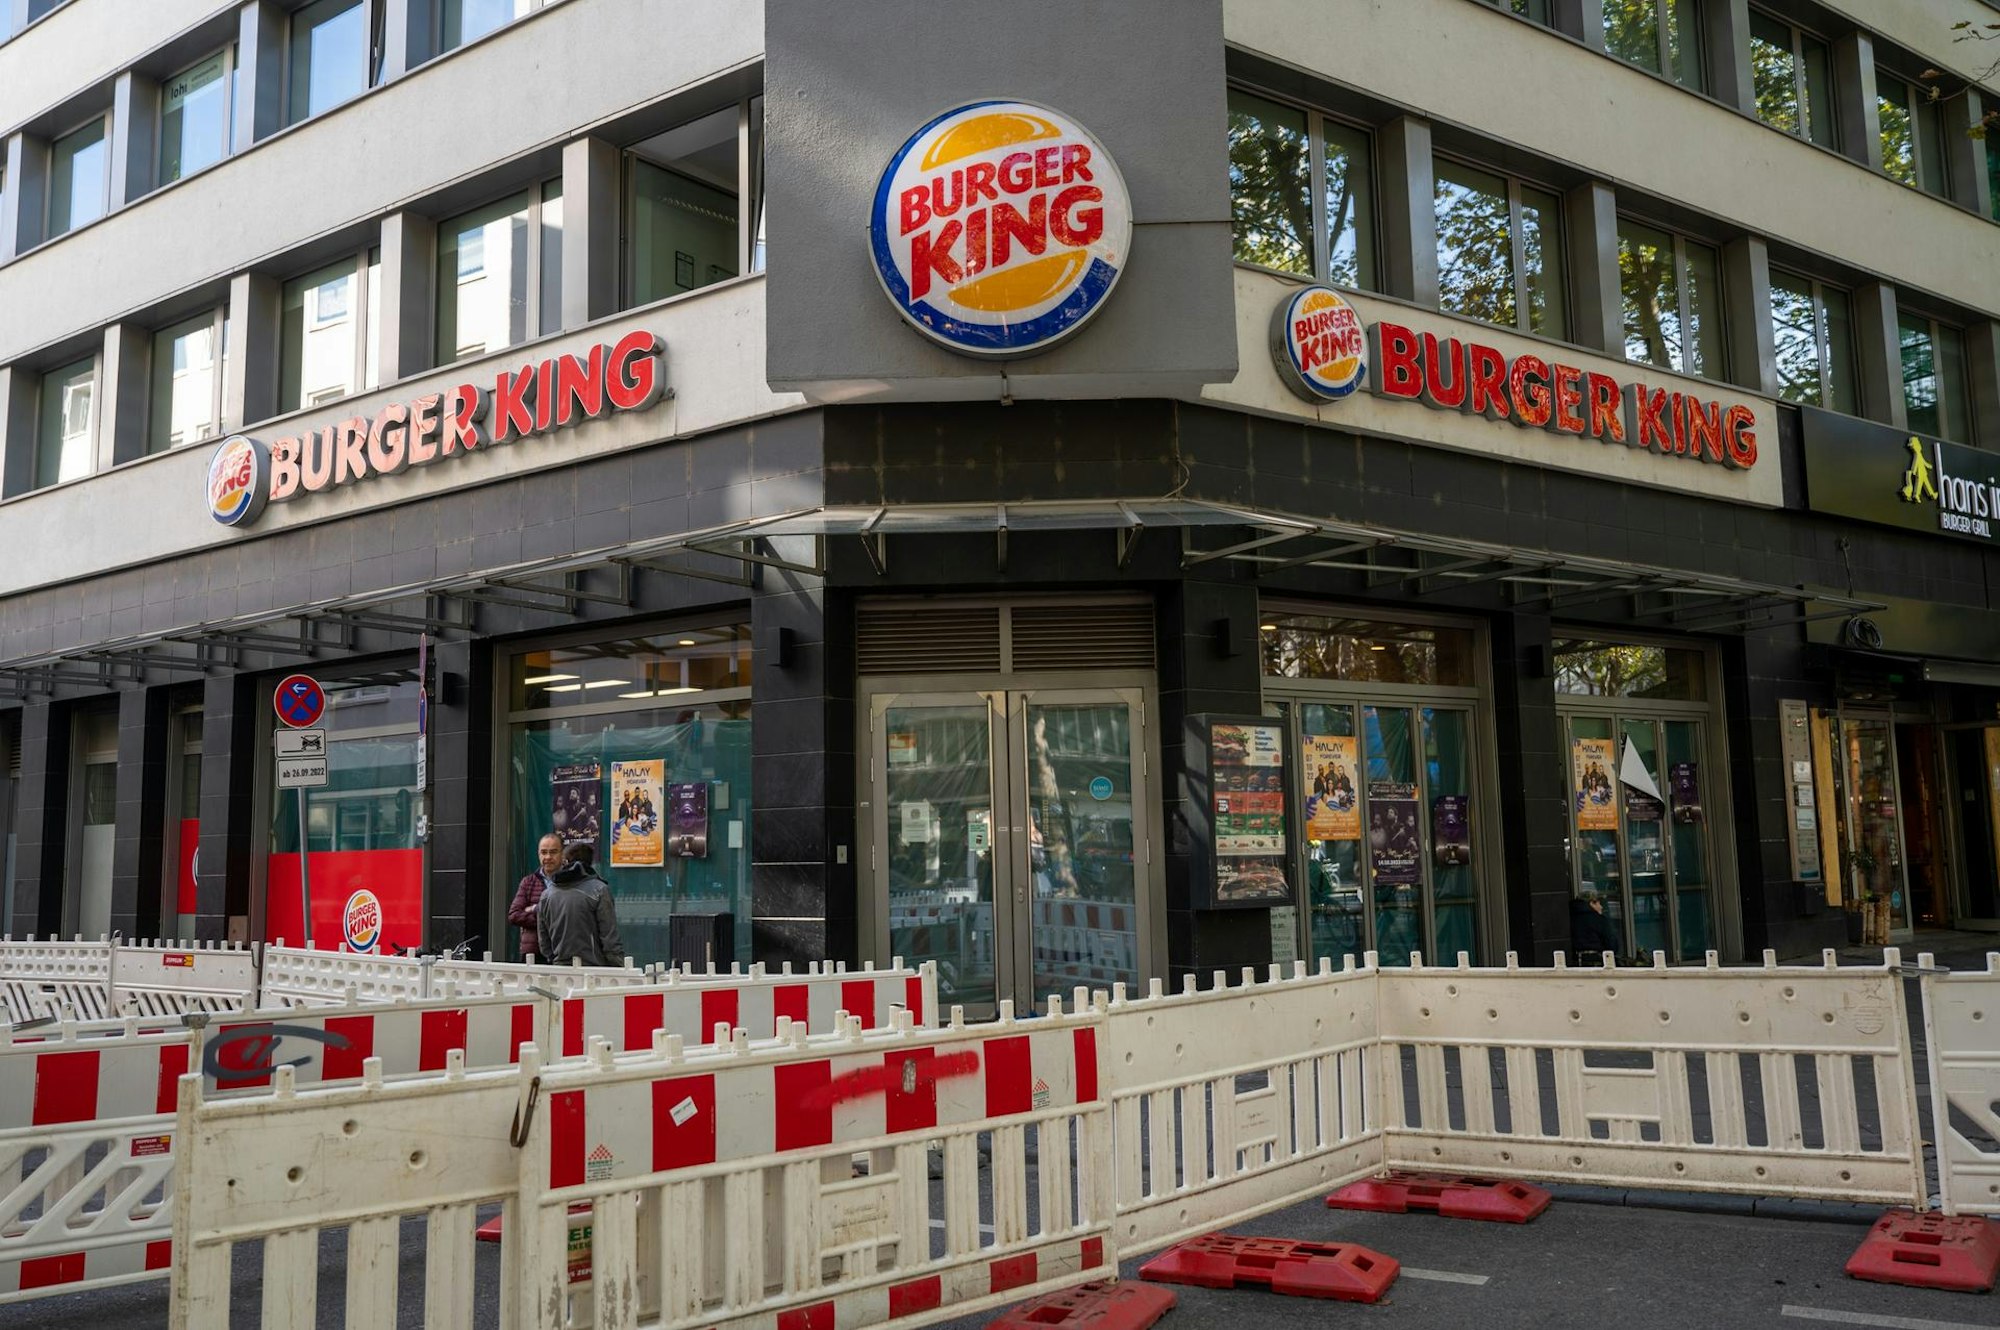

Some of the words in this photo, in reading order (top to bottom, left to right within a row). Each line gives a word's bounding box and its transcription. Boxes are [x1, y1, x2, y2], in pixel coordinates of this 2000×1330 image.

[901, 143, 1094, 236] BURGER
[911, 185, 1103, 301] KING
[1295, 309, 1357, 343] BURGER
[1301, 327, 1363, 372] KING
[1376, 321, 1625, 442] BURGER
[1630, 383, 1758, 469] KING
[269, 383, 480, 501] BURGER
[495, 329, 658, 441] KING
[1934, 442, 1989, 518] hans
[1941, 512, 1971, 534] BURGER
[1972, 518, 1992, 538] GRILL
[1315, 742, 1344, 753] HALAY
[1582, 744, 1604, 753] HALAY
[282, 768, 291, 778] ab
[292, 767, 325, 778] 26.09.2022
[623, 767, 651, 778] HALAY
[348, 901, 377, 924] BURGER
[350, 912, 377, 938] KING
